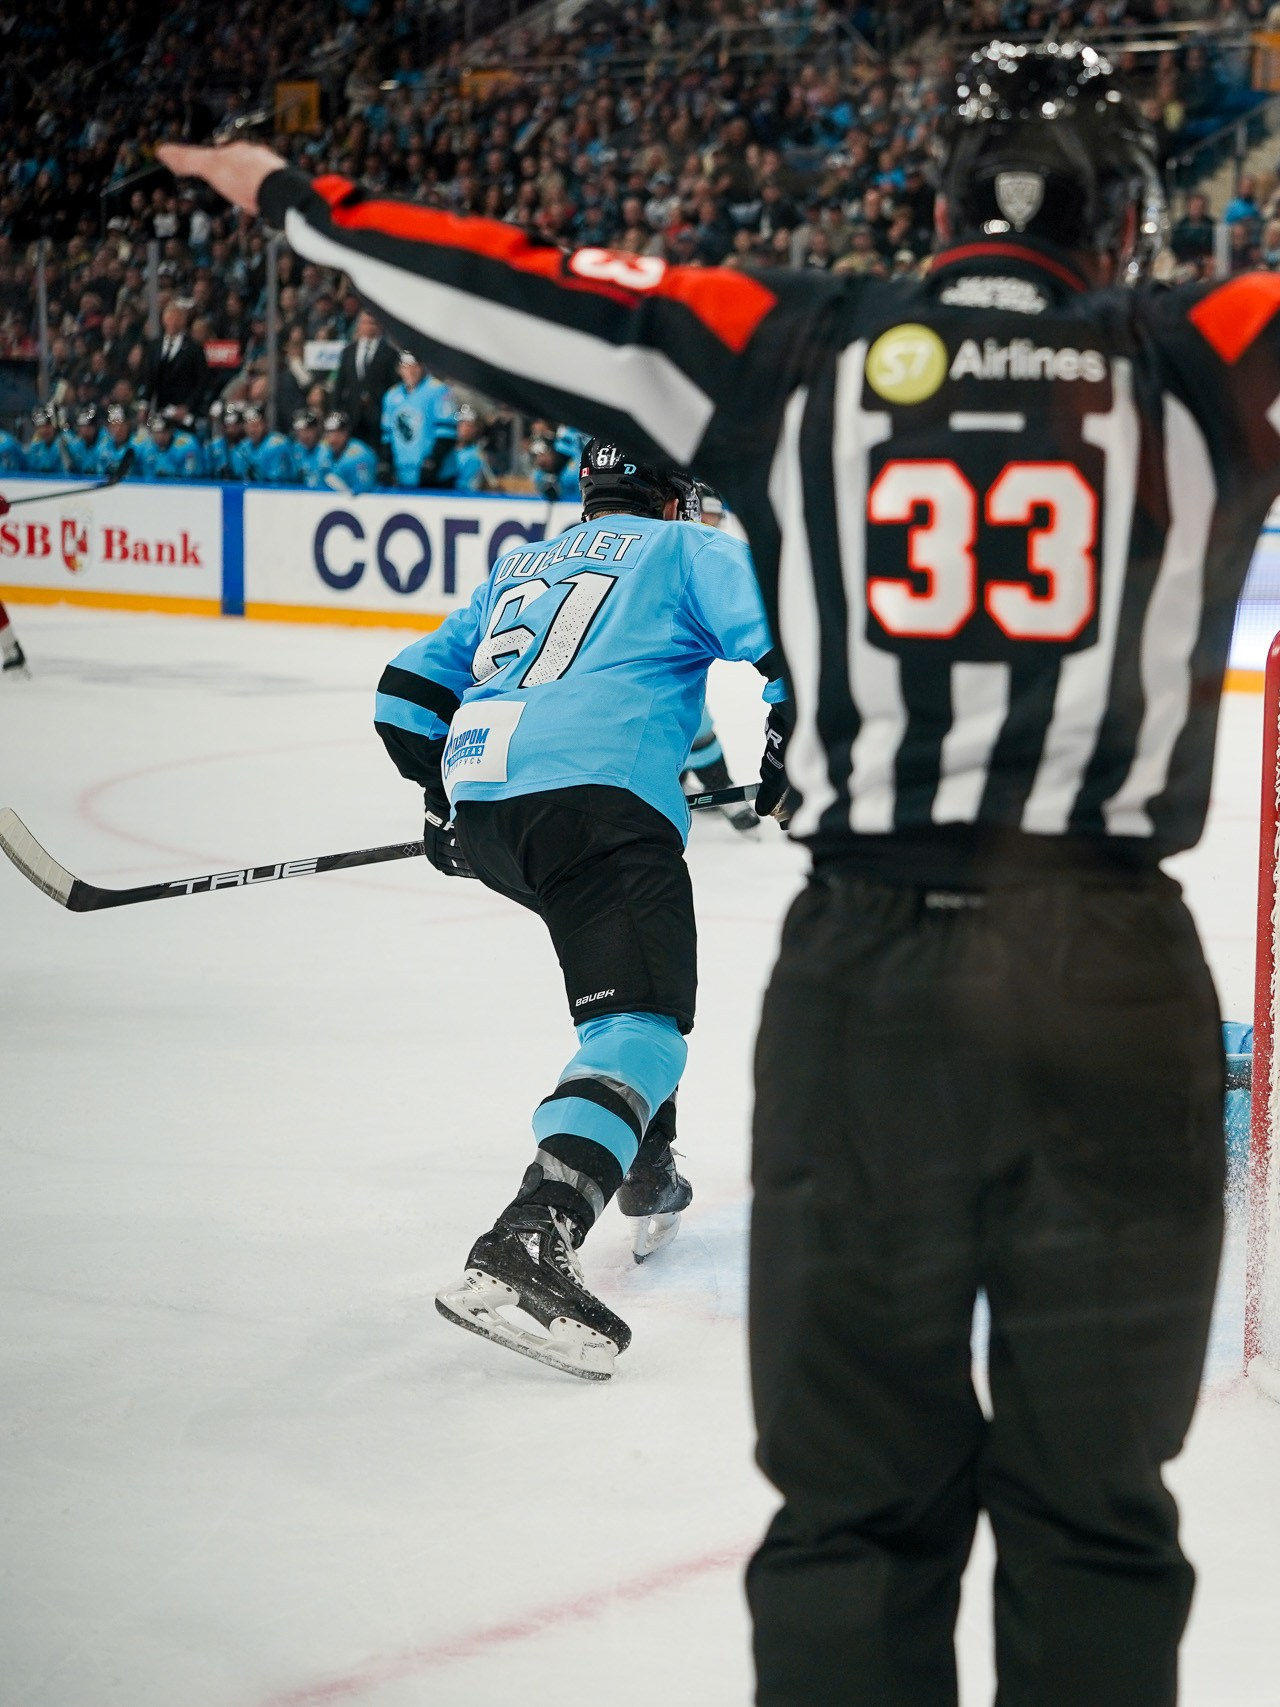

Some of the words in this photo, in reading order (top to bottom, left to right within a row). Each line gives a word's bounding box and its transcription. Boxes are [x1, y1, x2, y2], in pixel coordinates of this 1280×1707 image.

[950, 338, 1107, 383] Airlines
[596, 447, 617, 466] 61
[102, 527, 204, 567] Bank
[314, 510, 577, 594] сога
[866, 457, 1098, 643] 33
[471, 570, 619, 689] 61
[170, 858, 319, 894] TRUE
